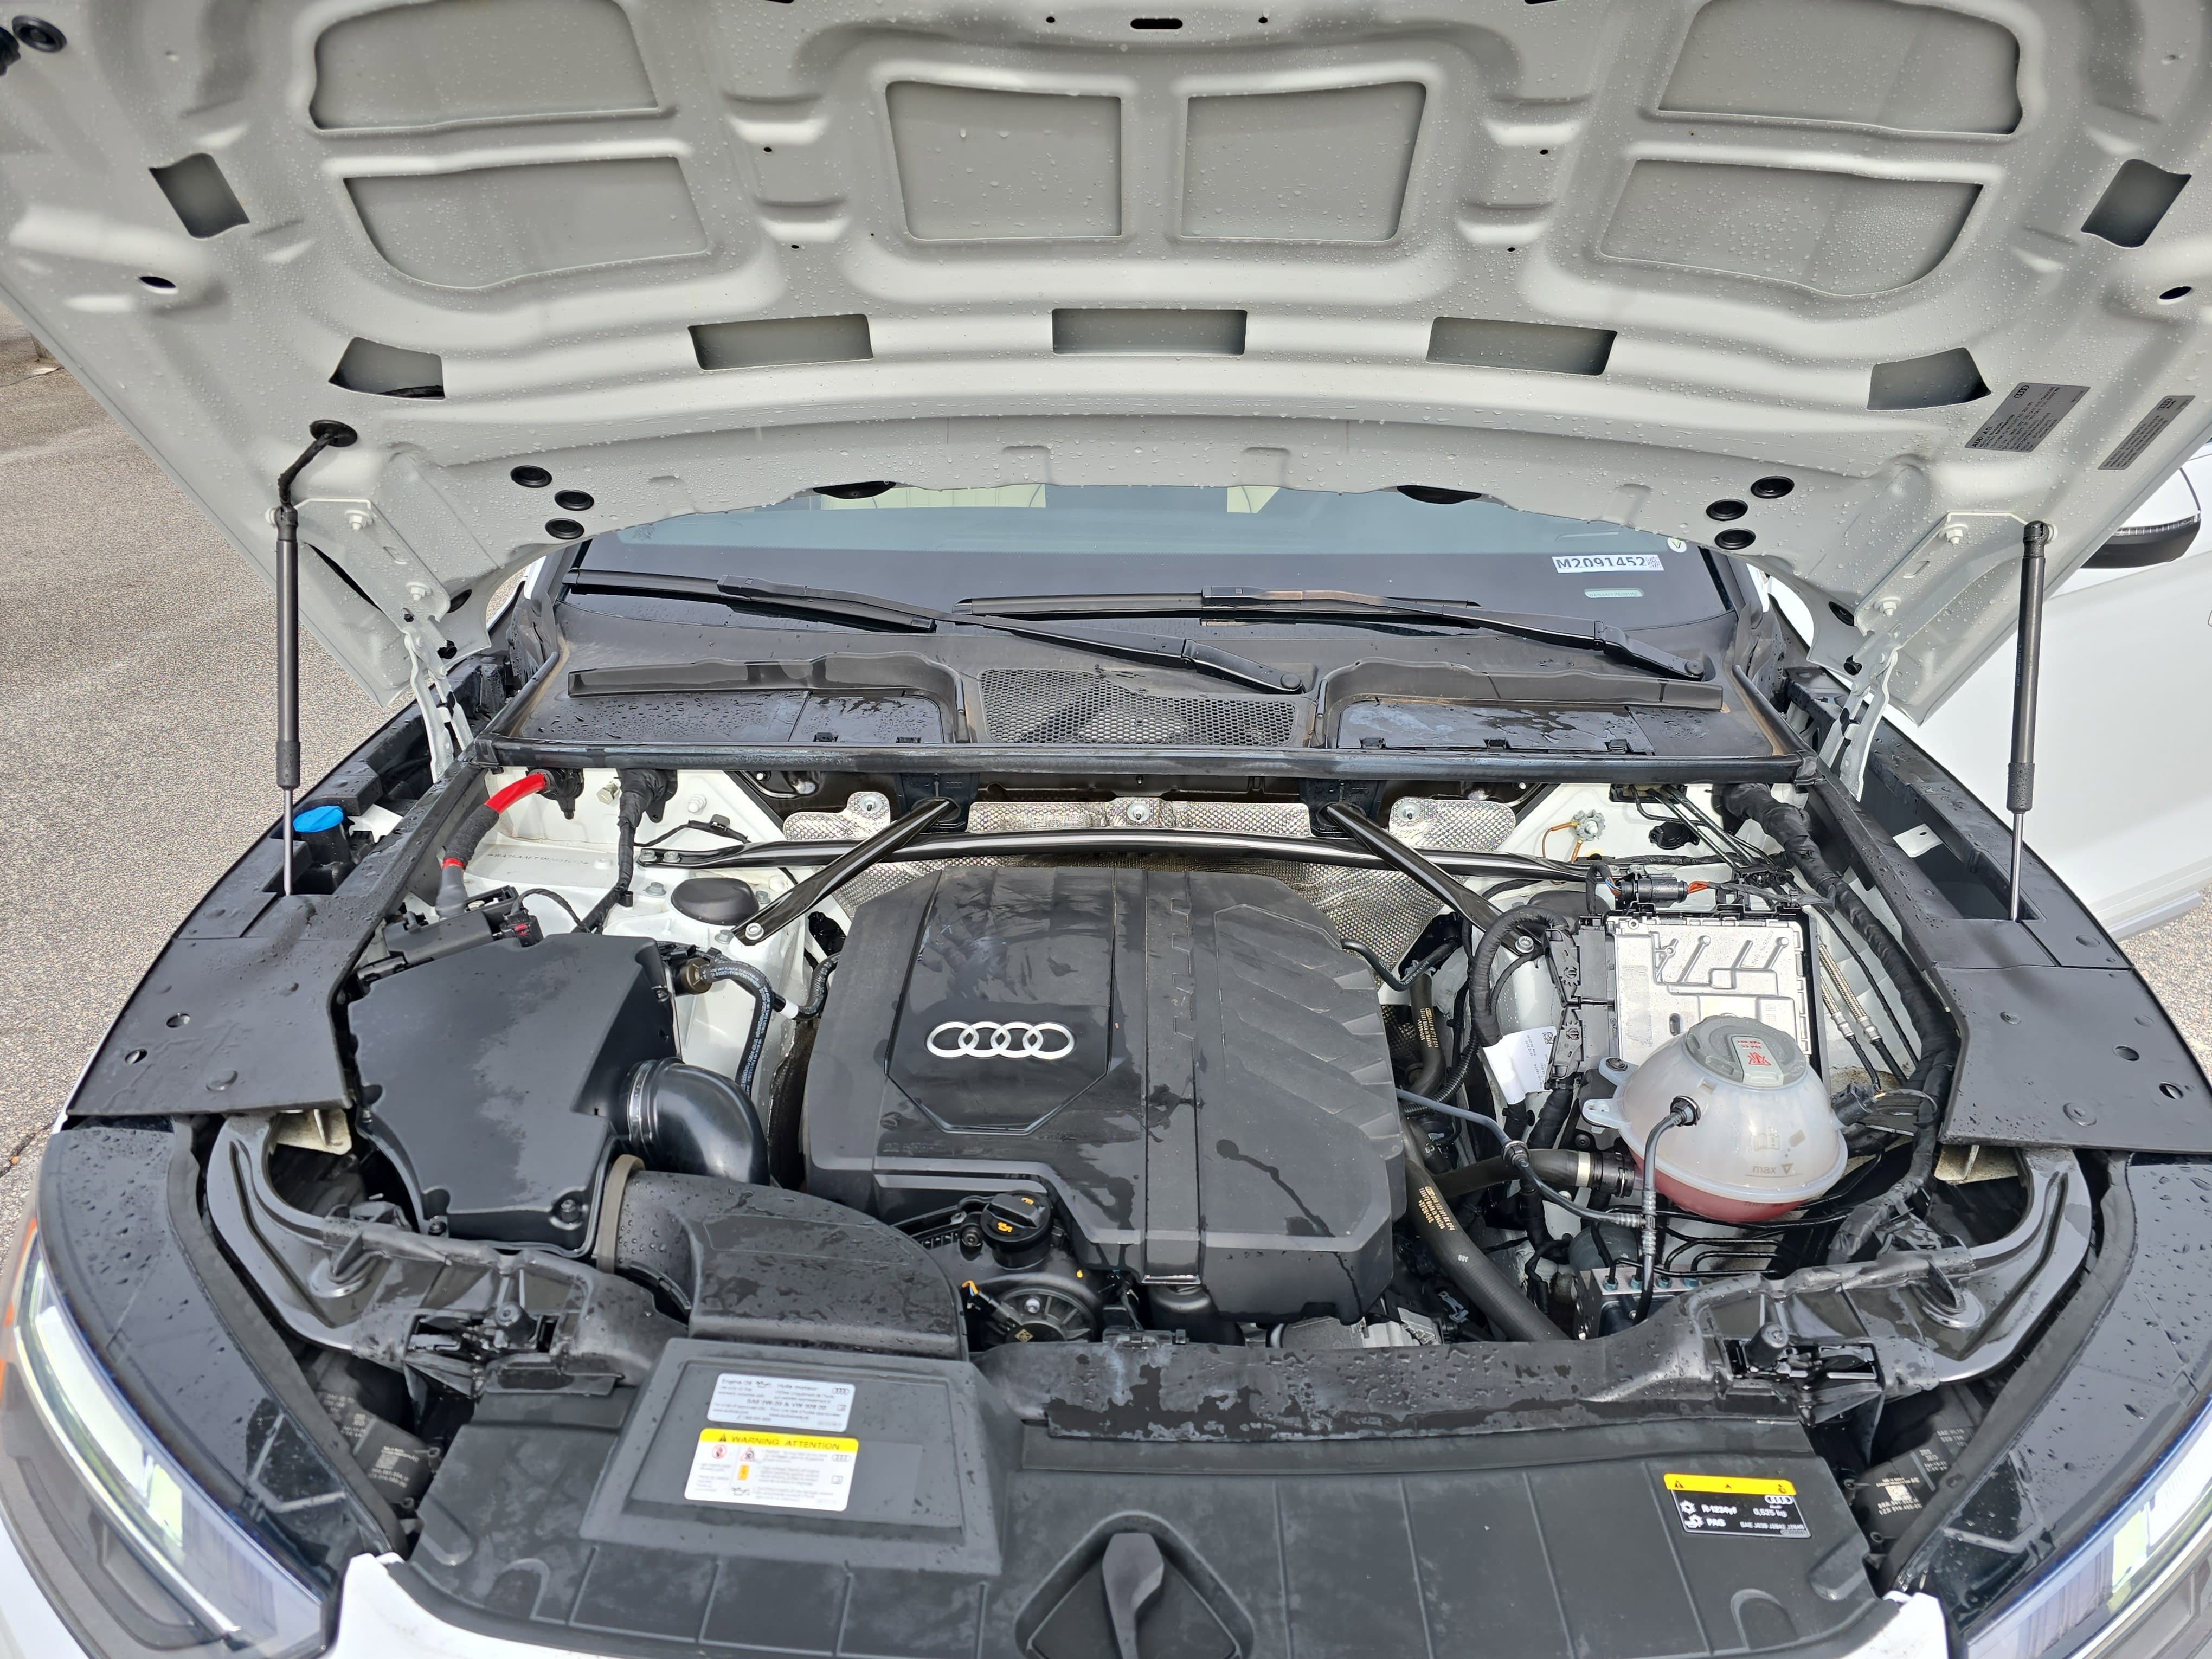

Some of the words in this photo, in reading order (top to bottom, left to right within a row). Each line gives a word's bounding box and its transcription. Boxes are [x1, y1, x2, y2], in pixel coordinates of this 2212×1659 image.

[1970, 435, 1985, 447] AUDI
[1556, 557, 1647, 568] M2091452
[1752, 1165, 1777, 1174] max
[731, 1436, 780, 1446] WARNING
[785, 1440, 840, 1450] ATTENTION
